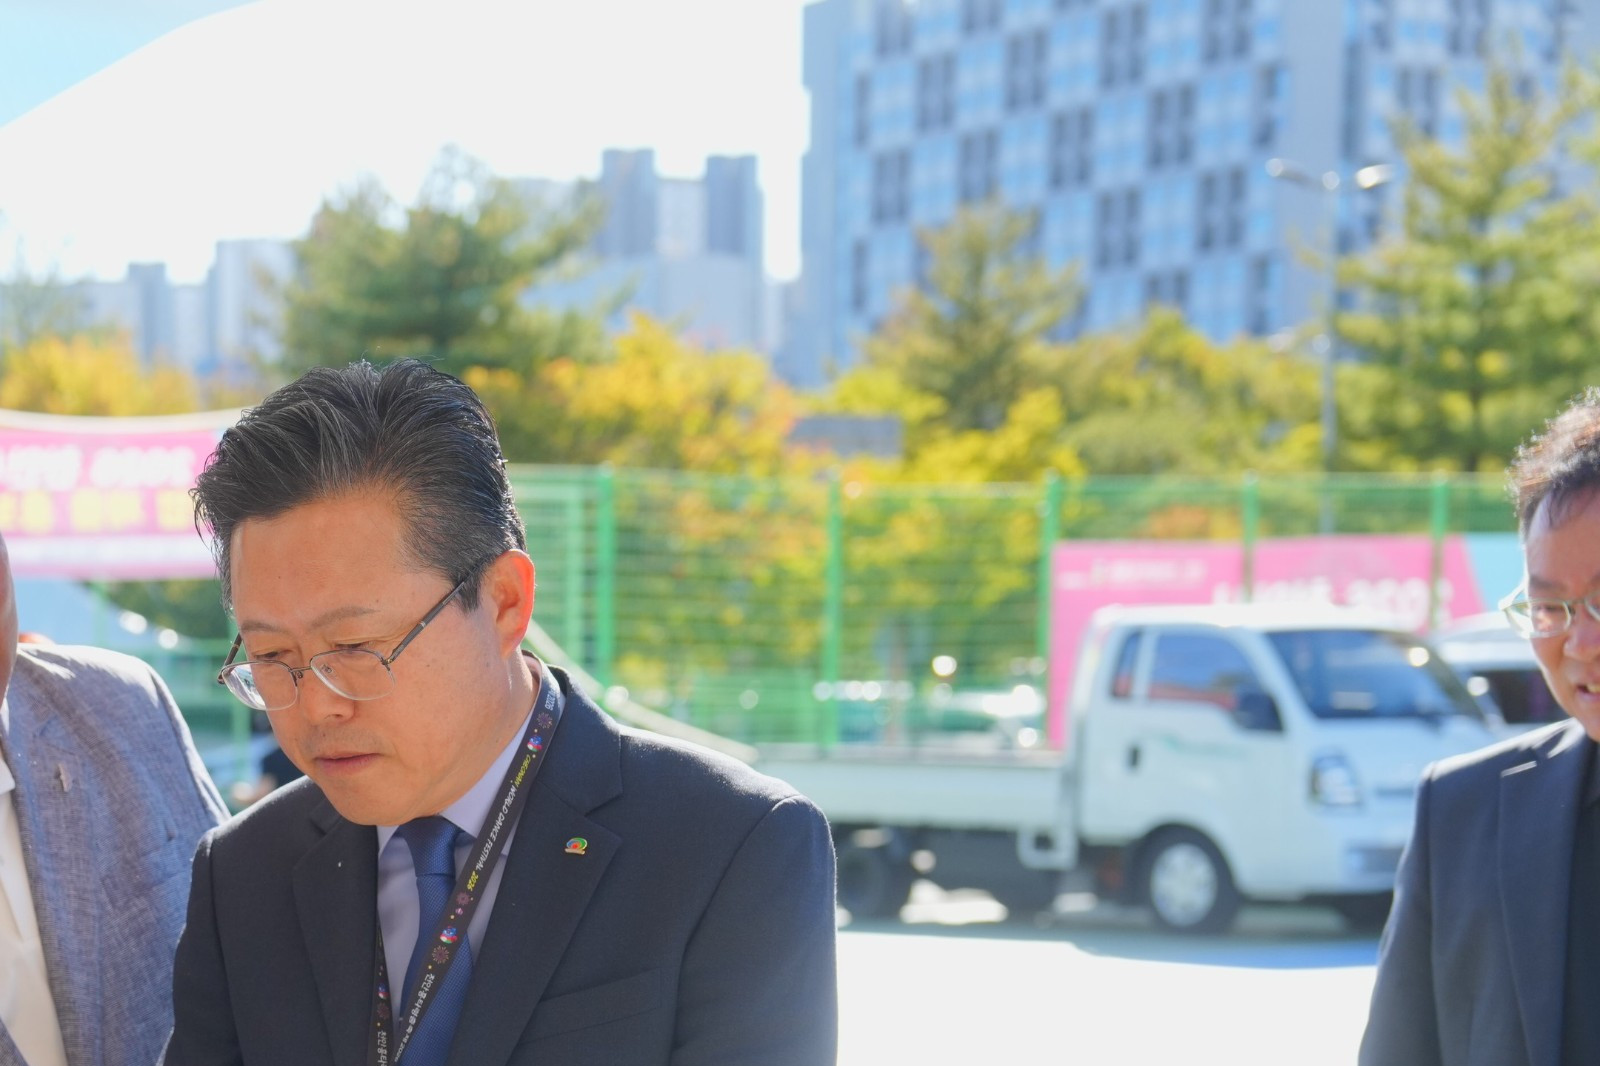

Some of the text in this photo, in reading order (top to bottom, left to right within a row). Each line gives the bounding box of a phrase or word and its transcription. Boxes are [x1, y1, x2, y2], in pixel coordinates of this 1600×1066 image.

[515, 754, 531, 787] CHEONAN
[502, 785, 517, 814] WORLD
[490, 812, 505, 842] DANCE
[475, 838, 493, 871] FESTIVAL
